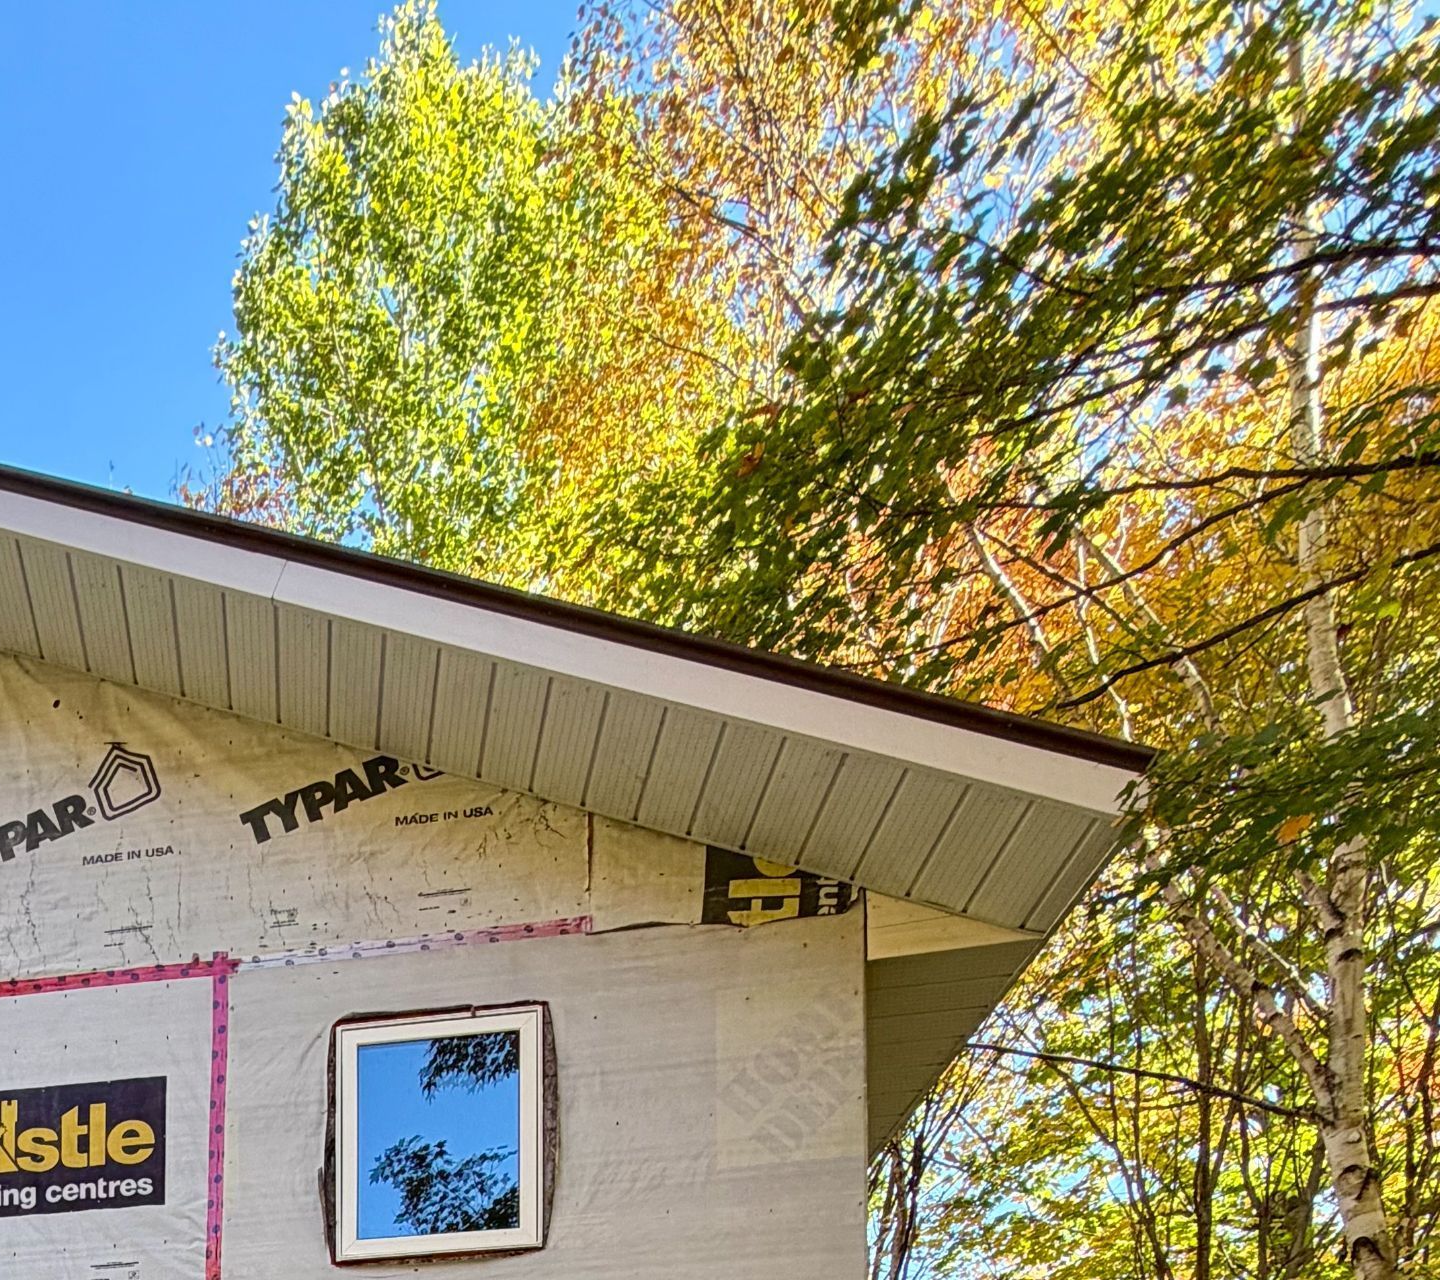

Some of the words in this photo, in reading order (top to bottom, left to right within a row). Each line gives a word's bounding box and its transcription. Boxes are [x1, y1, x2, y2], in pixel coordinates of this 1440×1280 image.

[240, 755, 407, 844] TYPAR
[395, 813, 439, 827] MADE
[442, 811, 458, 822] IN
[463, 807, 494, 818] USA
[82, 854, 124, 866] MADE
[128, 851, 142, 861] IN
[145, 846, 174, 858] USA
[45, 1176, 153, 1204] centres
